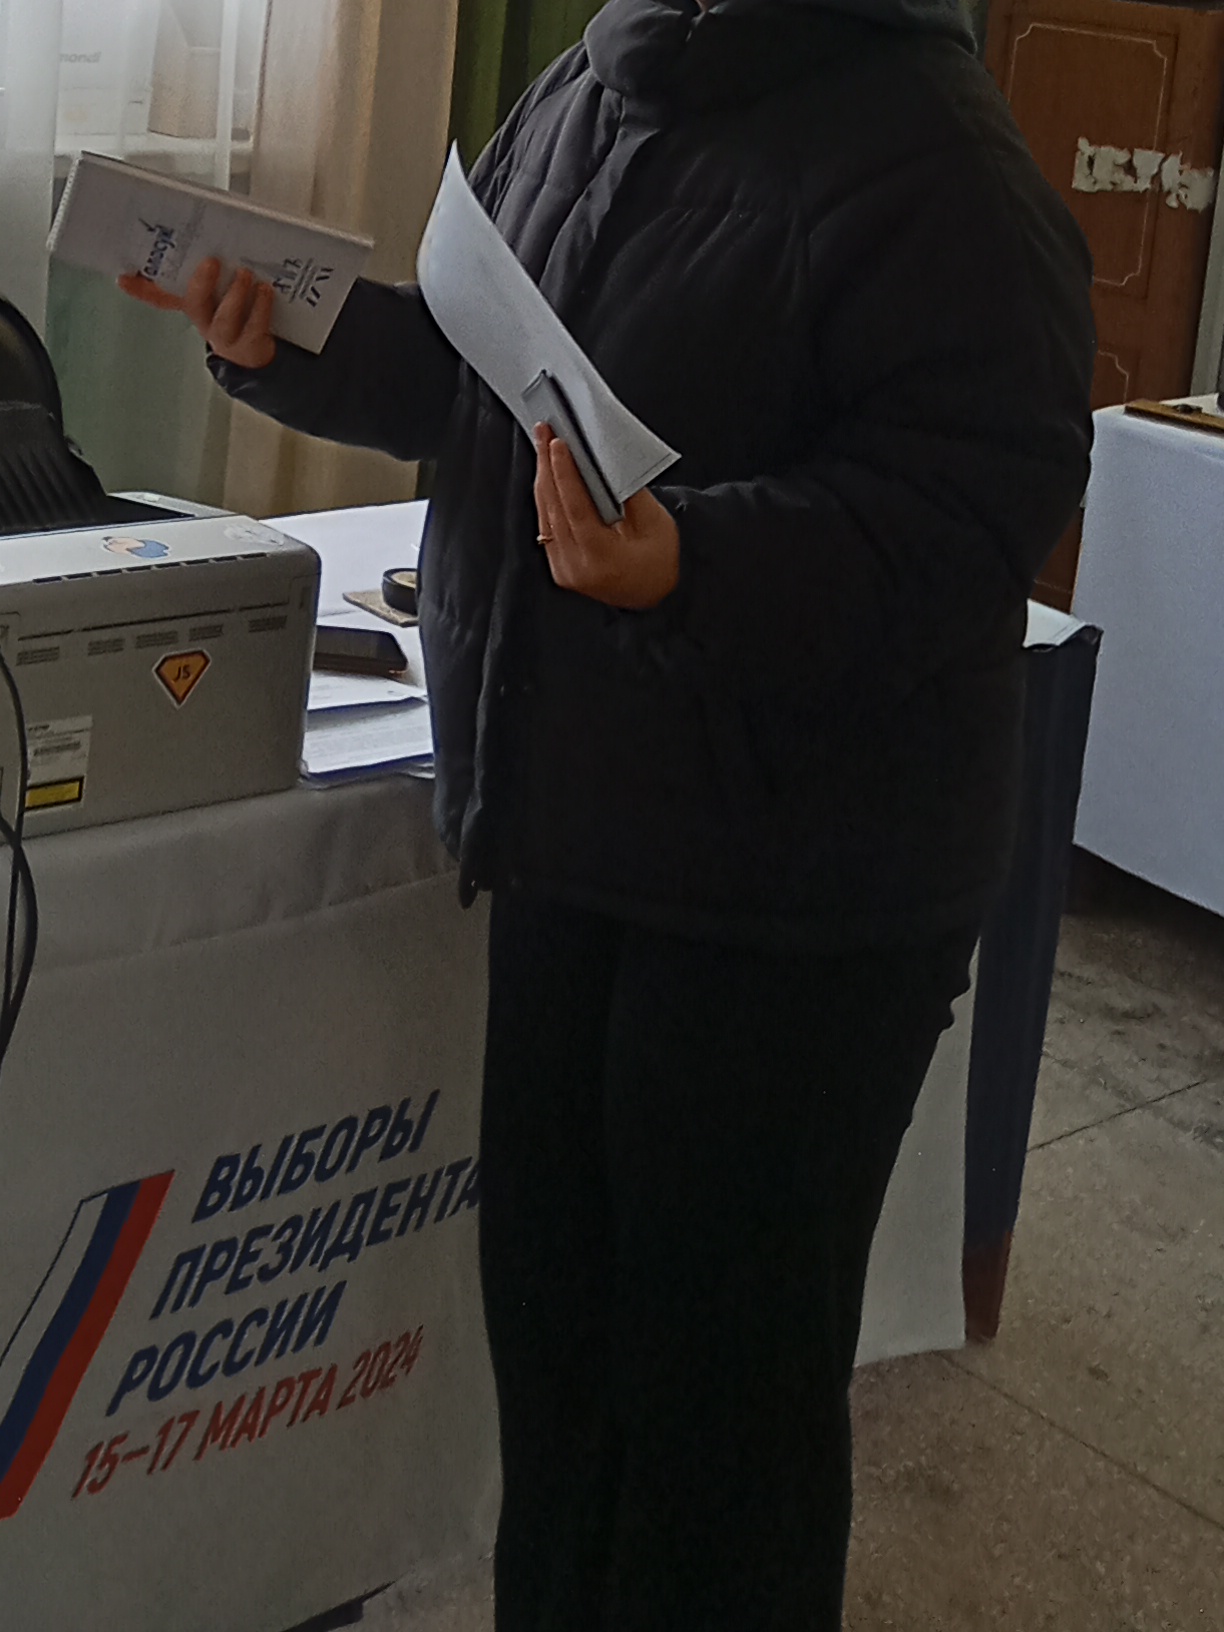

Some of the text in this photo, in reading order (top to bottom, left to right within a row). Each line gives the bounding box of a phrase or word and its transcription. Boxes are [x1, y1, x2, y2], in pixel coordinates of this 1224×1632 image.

[192, 1089, 440, 1223] ВЫБОРЫ
[149, 1156, 480, 1320] ПРЕЗИДЕНТА
[106, 1281, 347, 1416] РОССИИ
[193, 1363, 338, 1460] МАРТА
[336, 1324, 424, 1410] 2024
